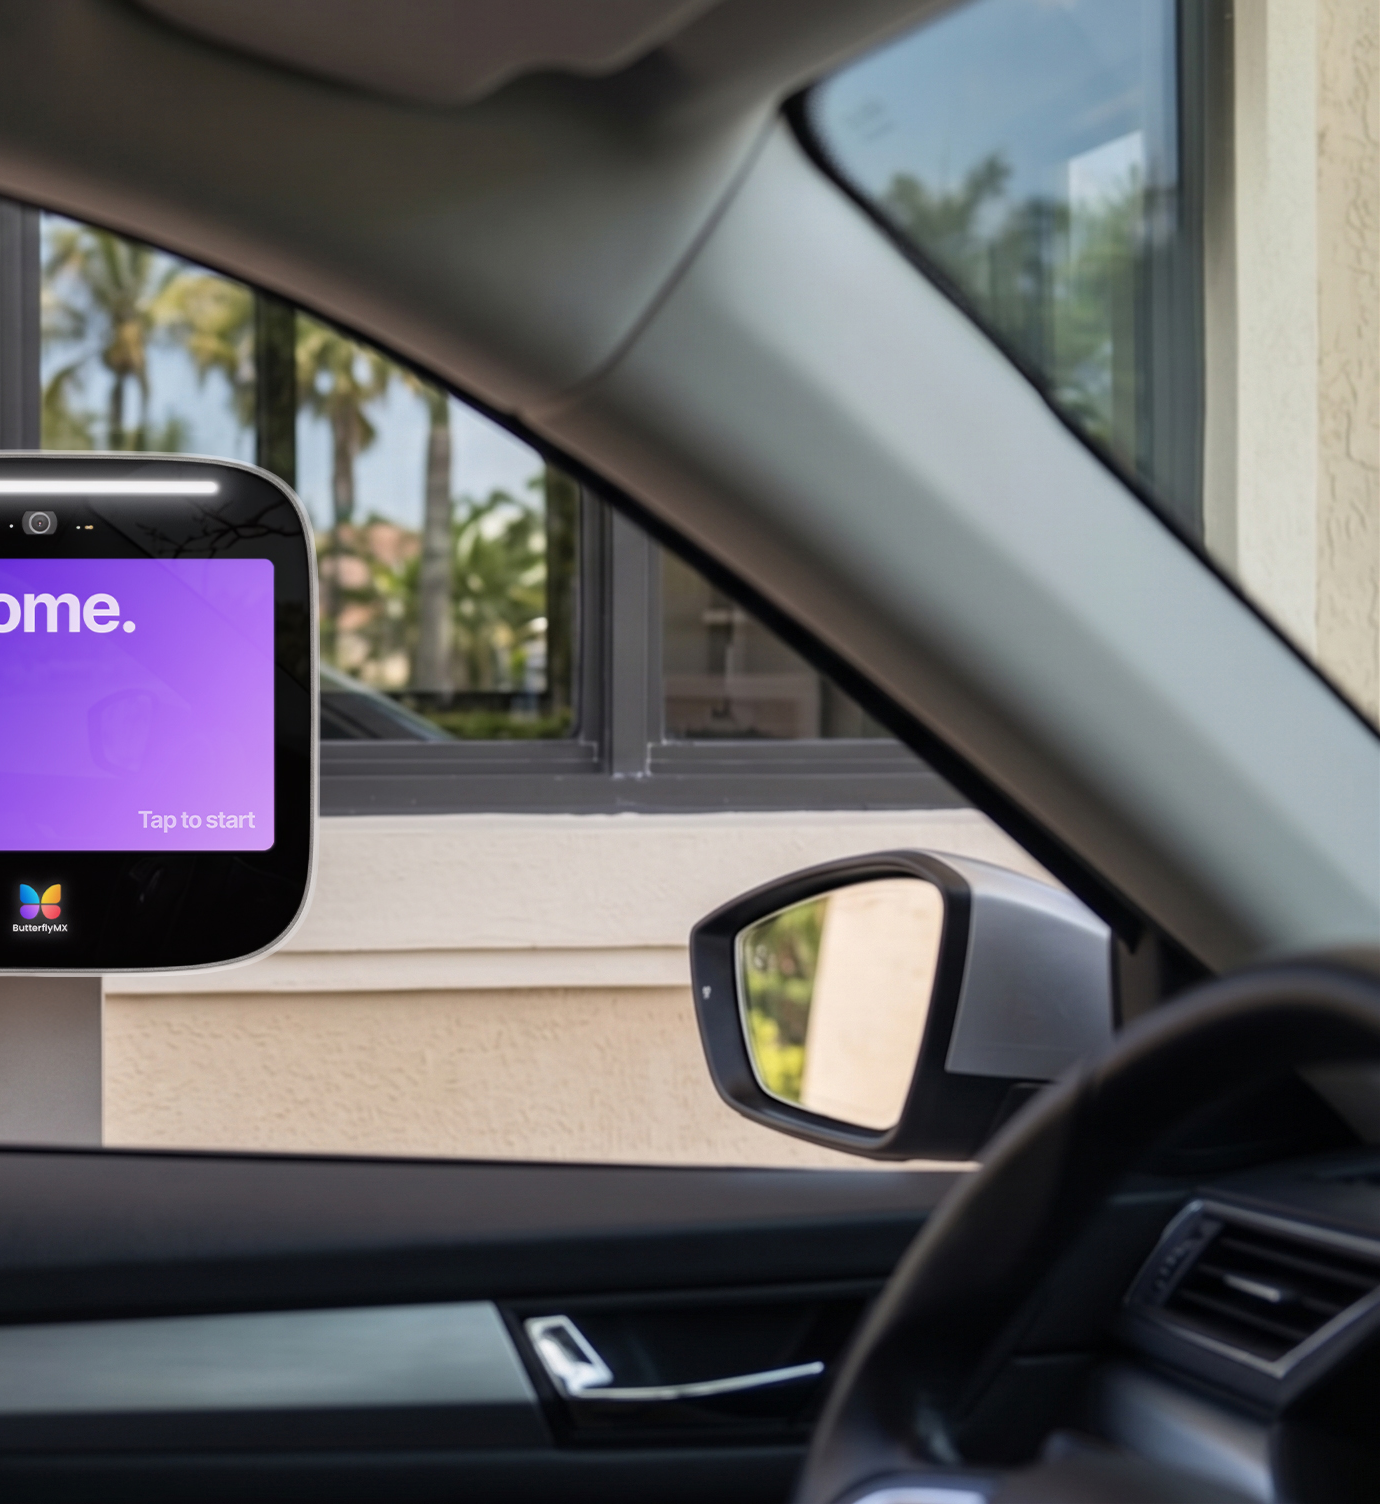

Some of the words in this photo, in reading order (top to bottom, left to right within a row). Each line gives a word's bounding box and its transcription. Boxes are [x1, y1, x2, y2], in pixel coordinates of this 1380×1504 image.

[138, 810, 177, 833] Tap
[180, 812, 202, 828] to
[206, 812, 256, 828] start
[12, 923, 68, 934] ButterflyMX
